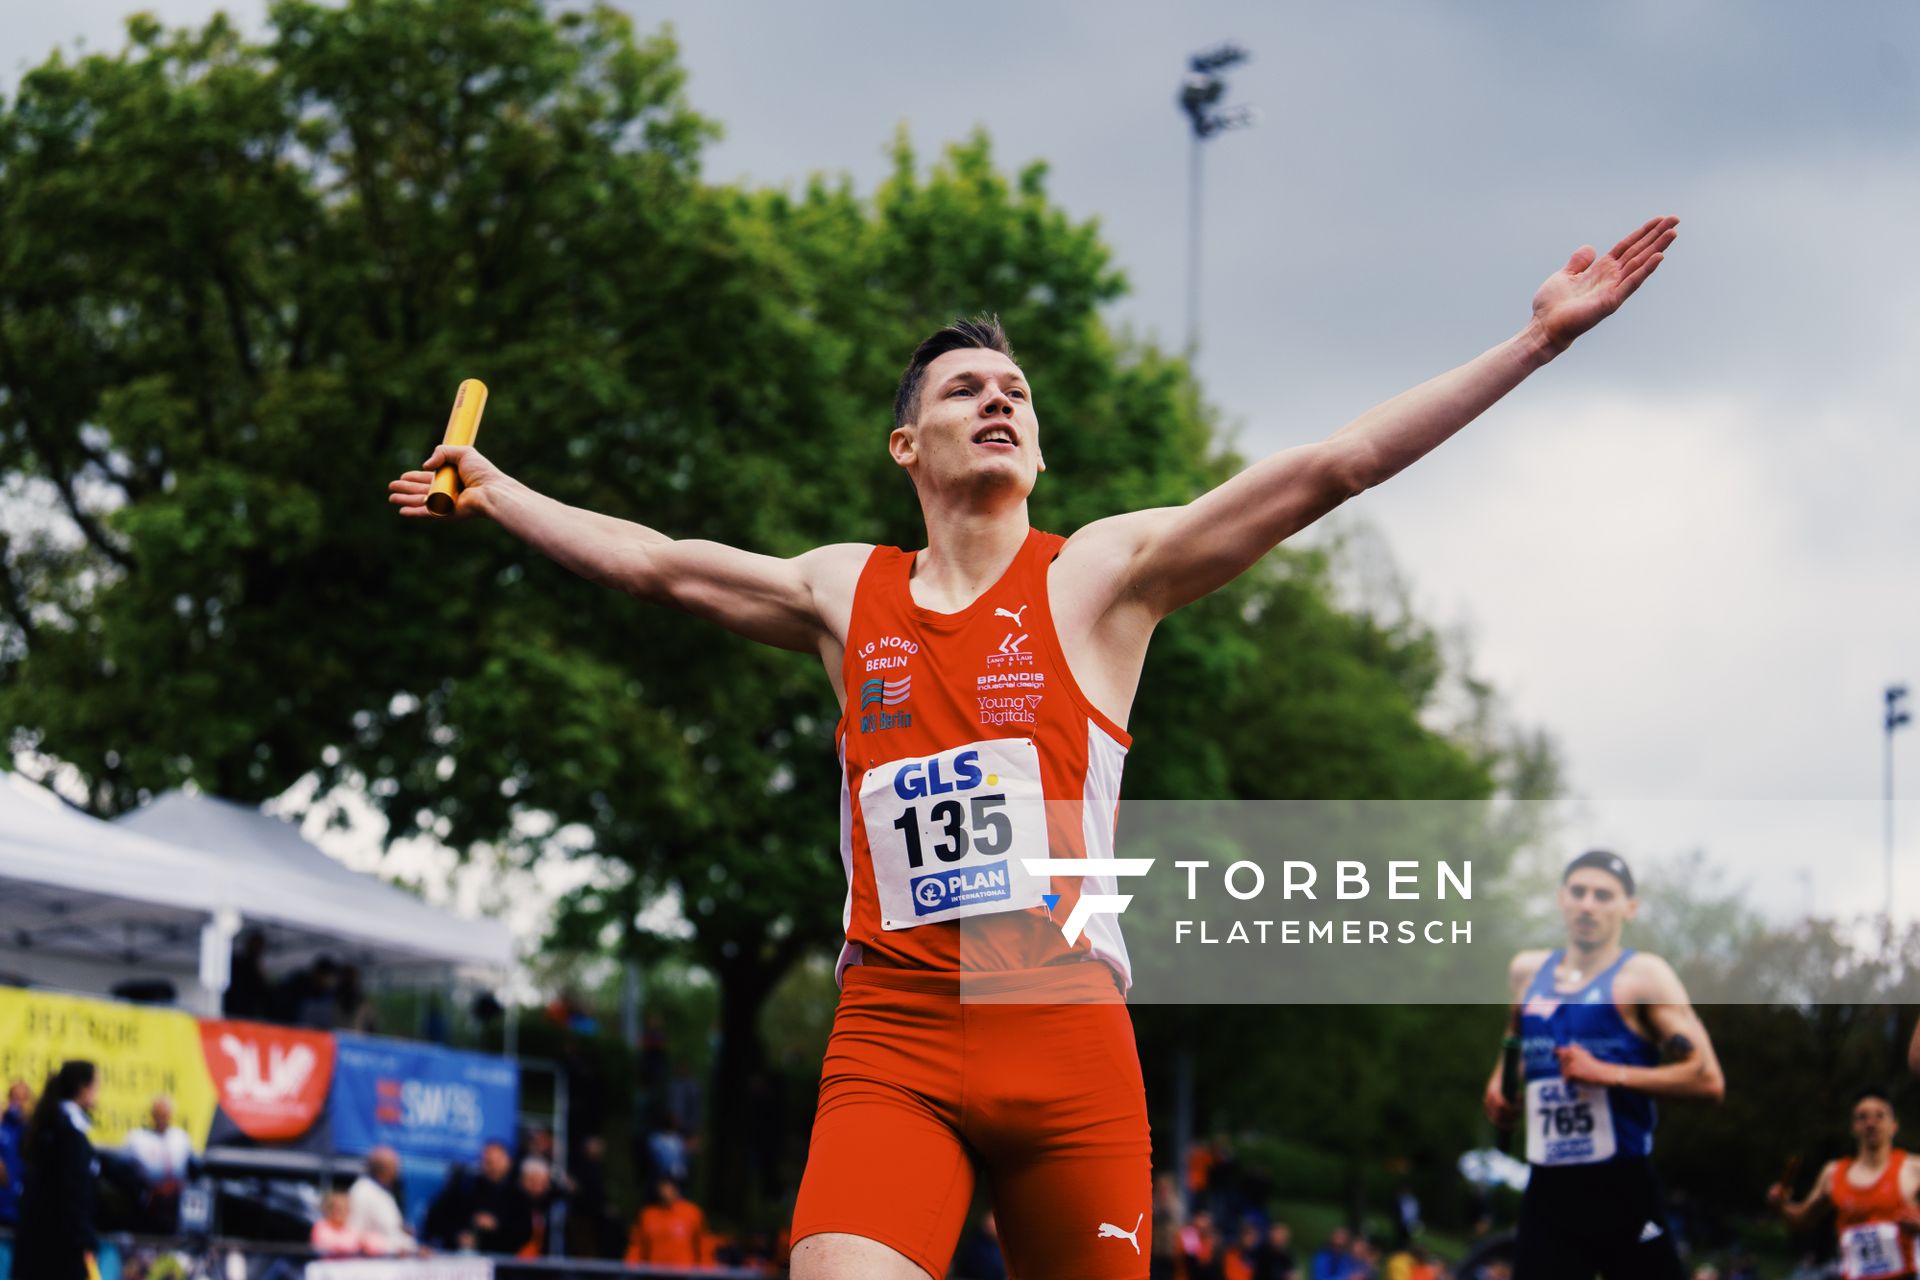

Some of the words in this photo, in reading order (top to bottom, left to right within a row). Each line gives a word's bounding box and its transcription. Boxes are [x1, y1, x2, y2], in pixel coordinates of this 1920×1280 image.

[858, 642, 875, 659] LG
[880, 636, 919, 654] NORD
[866, 656, 908, 672] BERLIN
[977, 673, 1044, 684] BRANDIS
[977, 696, 1025, 711] Young
[880, 710, 912, 730] Berlin
[980, 709, 1035, 725] Digitals
[894, 793, 1012, 868] 135
[949, 869, 1005, 893] PLAN
[951, 889, 1007, 902] INTERNATIONAL
[1538, 1103, 1594, 1137] 765
